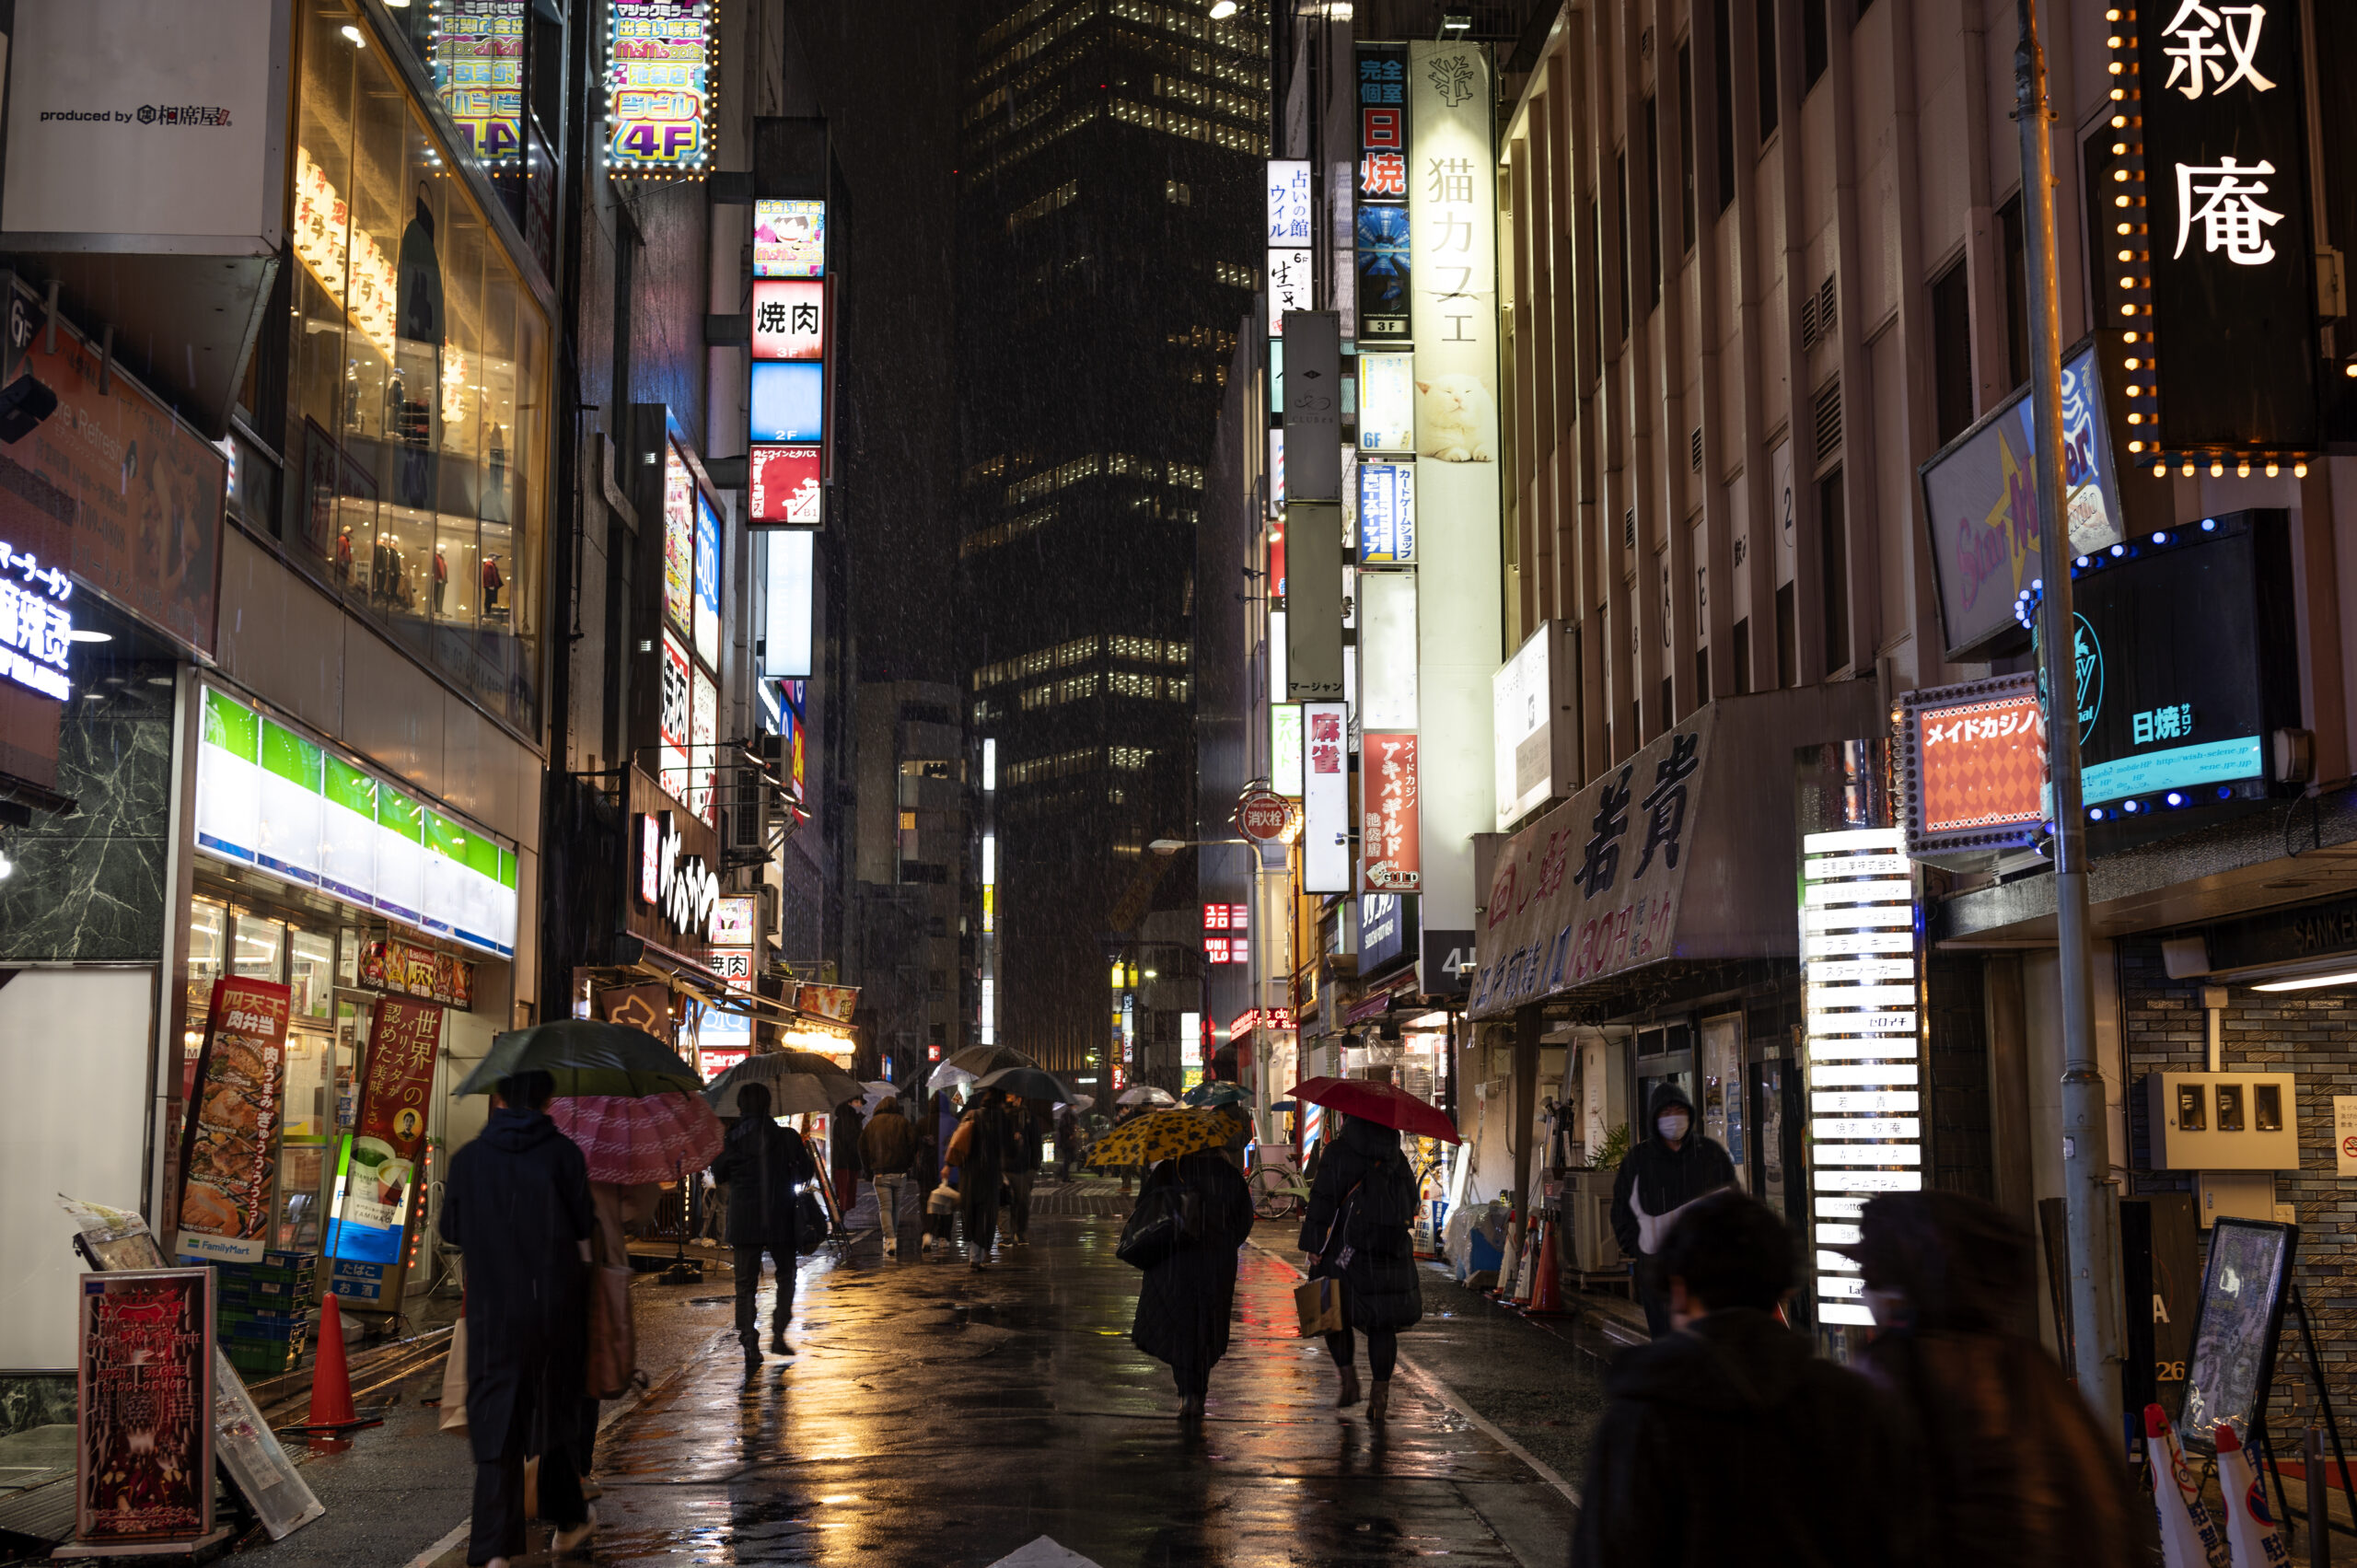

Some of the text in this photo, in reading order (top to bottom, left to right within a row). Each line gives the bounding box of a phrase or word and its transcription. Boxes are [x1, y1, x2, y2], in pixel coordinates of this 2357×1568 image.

[619, 19, 701, 38] 出会い喫茶
[629, 65, 689, 85] 池袋店
[1360, 60, 1403, 81] 完全
[620, 95, 697, 117] 当ビル
[1360, 82, 1403, 104] 個室
[40, 110, 110, 122] produced
[114, 110, 134, 123] by
[623, 122, 695, 159] 4F
[2161, 0, 2285, 266] 叙庵
[1360, 108, 1407, 195] 日焼
[1269, 185, 1289, 239] ウィル
[1290, 169, 1309, 238] 占いの館
[1428, 157, 1477, 342] 猫カフェ
[757, 301, 819, 335] 焼肉
[1376, 321, 1396, 331] 3F
[776, 347, 798, 357] 3F
[775, 430, 797, 440] 2F
[1363, 431, 1381, 448] 6F
[1399, 469, 1413, 559] カードゲームショップ
[1956, 516, 2006, 612] Star
[1289, 682, 1342, 692] マージャン
[1925, 710, 2038, 749] メイドカジノ
[2133, 704, 2182, 745] 日焼
[1311, 713, 1341, 774] 麻雀
[1405, 740, 1416, 808] メイドカジノ
[1381, 741, 1401, 857] アキバギルド
[1248, 809, 1283, 827] 消火栓
[1366, 812, 1381, 857] 池袋店
[1382, 871, 1420, 883] GUILD
[1205, 905, 1228, 916] ユニ
[1205, 917, 1228, 928] クロ
[1205, 939, 1227, 950] UNI
[221, 989, 287, 1028] 四天王
[226, 1010, 275, 1036] 肉弁当
[367, 1003, 403, 1125] 認めた美味しさ
[387, 1020, 414, 1098] バリスタが
[404, 1009, 438, 1106] 世界一の
[202, 1240, 250, 1256] FamilyMart
[342, 1263, 376, 1277] たばこ
